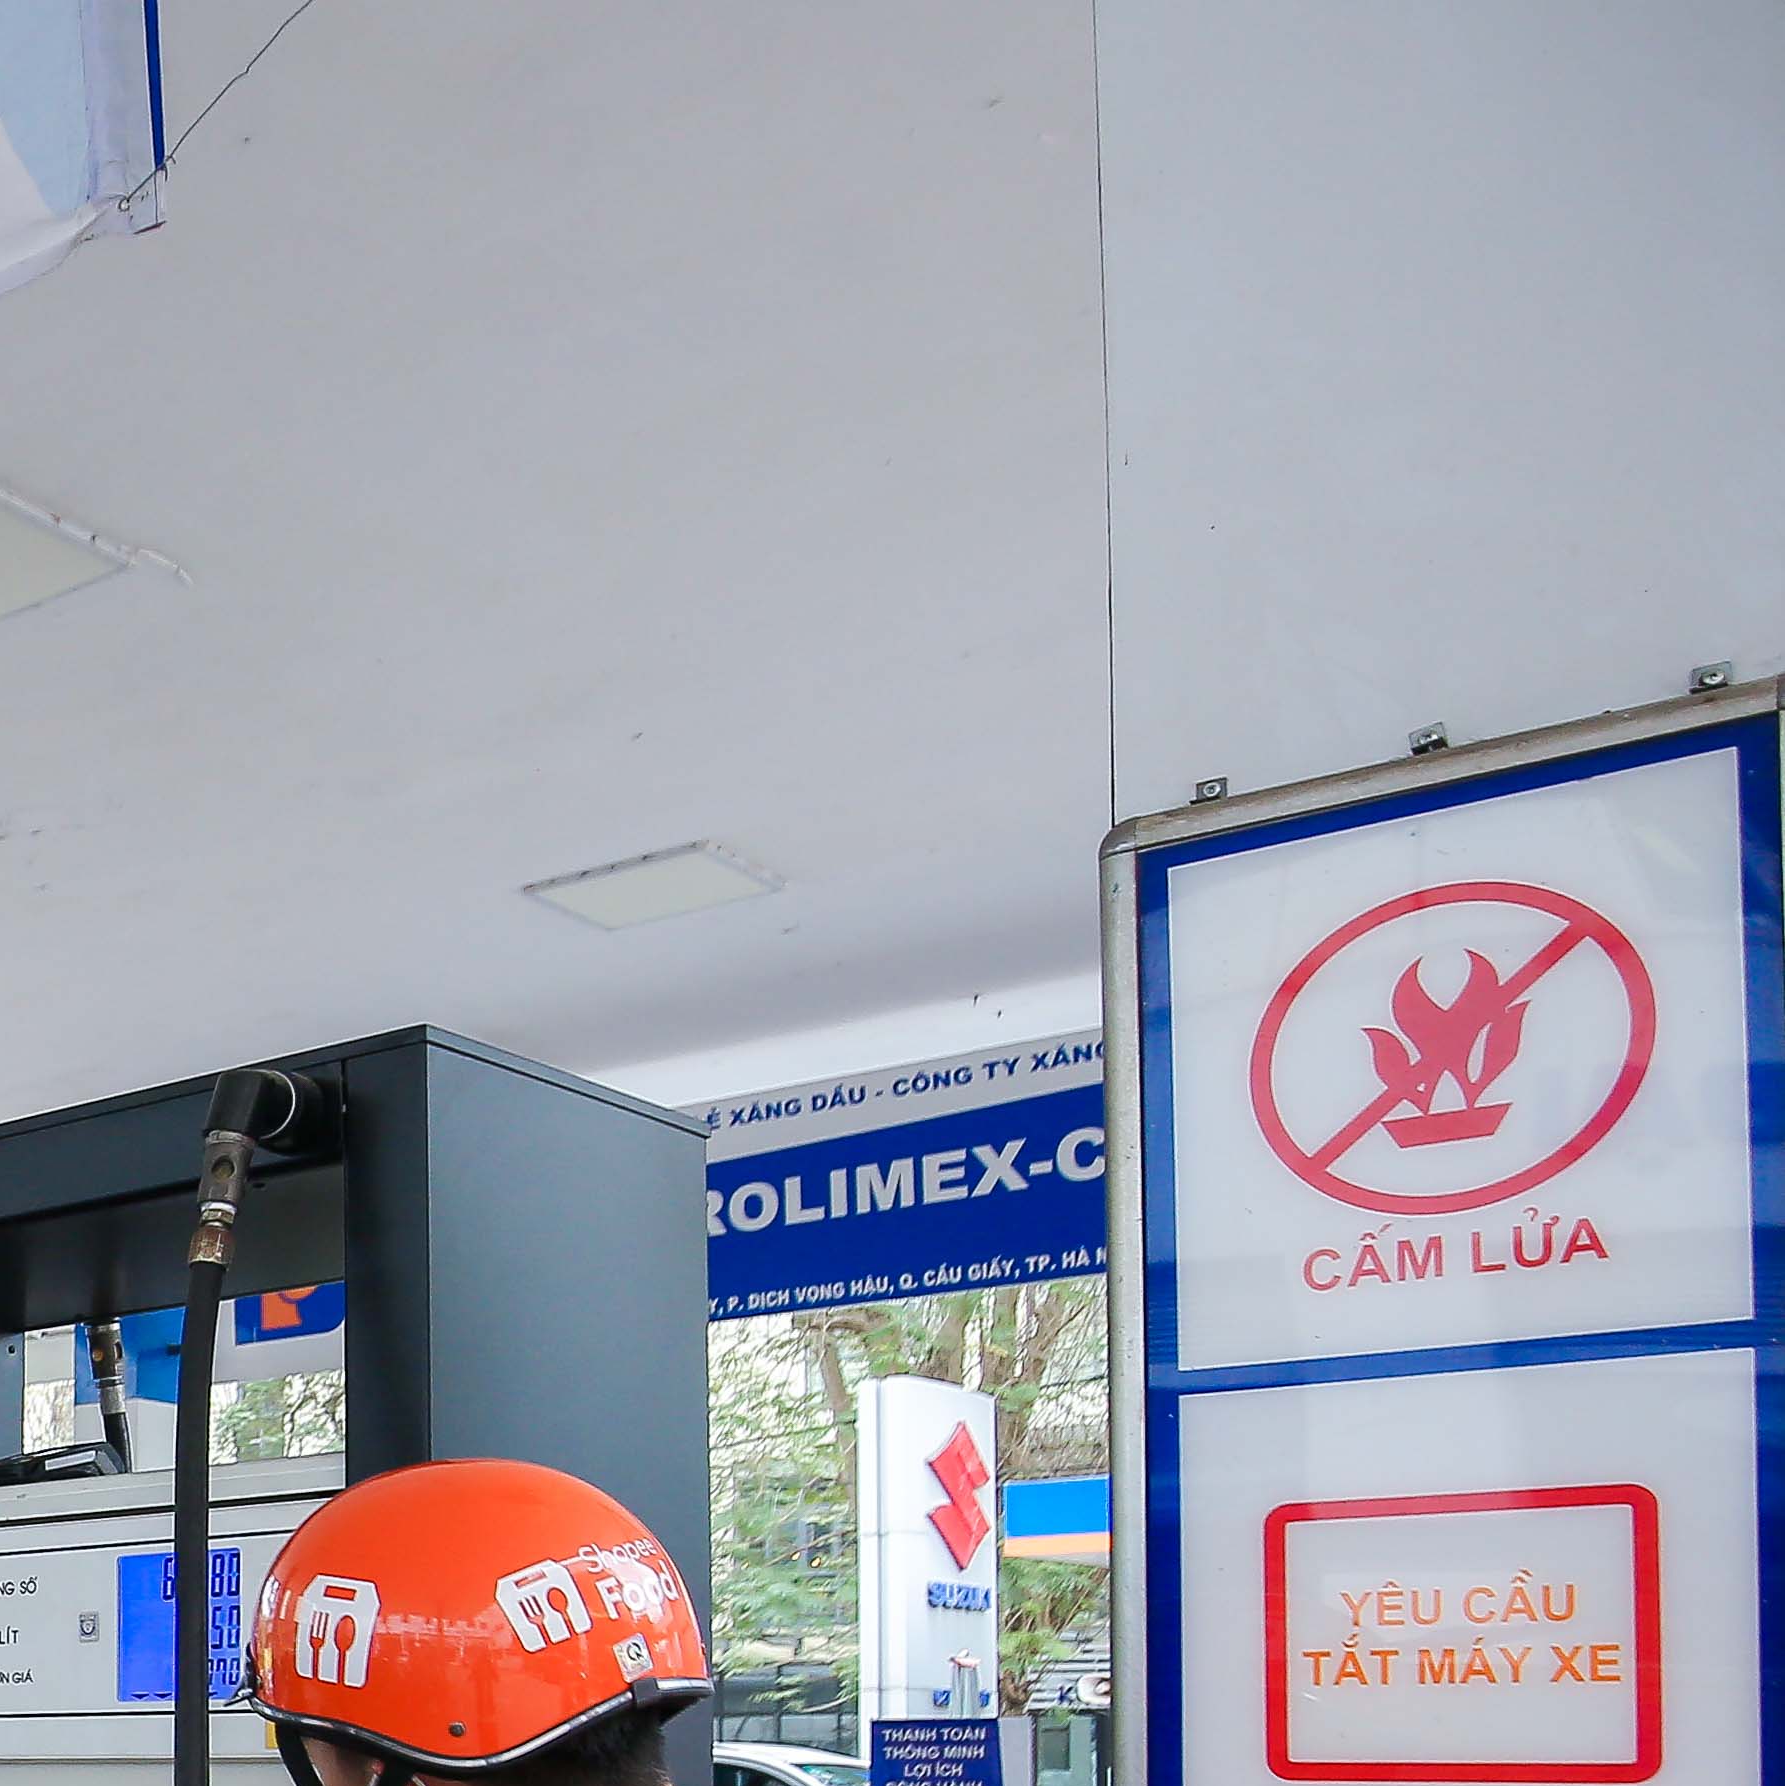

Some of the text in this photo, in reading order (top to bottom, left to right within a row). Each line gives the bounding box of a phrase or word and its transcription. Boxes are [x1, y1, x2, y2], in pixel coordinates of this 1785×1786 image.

[892, 1065, 973, 1098] CÔNG
[983, 1056, 1020, 1080] TY
[1026, 1253, 1056, 1276] TP.
[1062, 1245, 1090, 1268] HÀ
[1302, 1207, 1609, 1292] CẤM LỬA
[578, 1537, 658, 1573] Shopee
[19, 1576, 38, 1595] SỐ
[595, 1560, 681, 1620] Food
[1338, 1568, 1577, 1628] YÊU CẦU
[1301, 1632, 1622, 1687] TẮT MÁY XE
[881, 1725, 986, 1742] THANH TOÁN
[882, 1743, 986, 1760] THÔNG MINH
